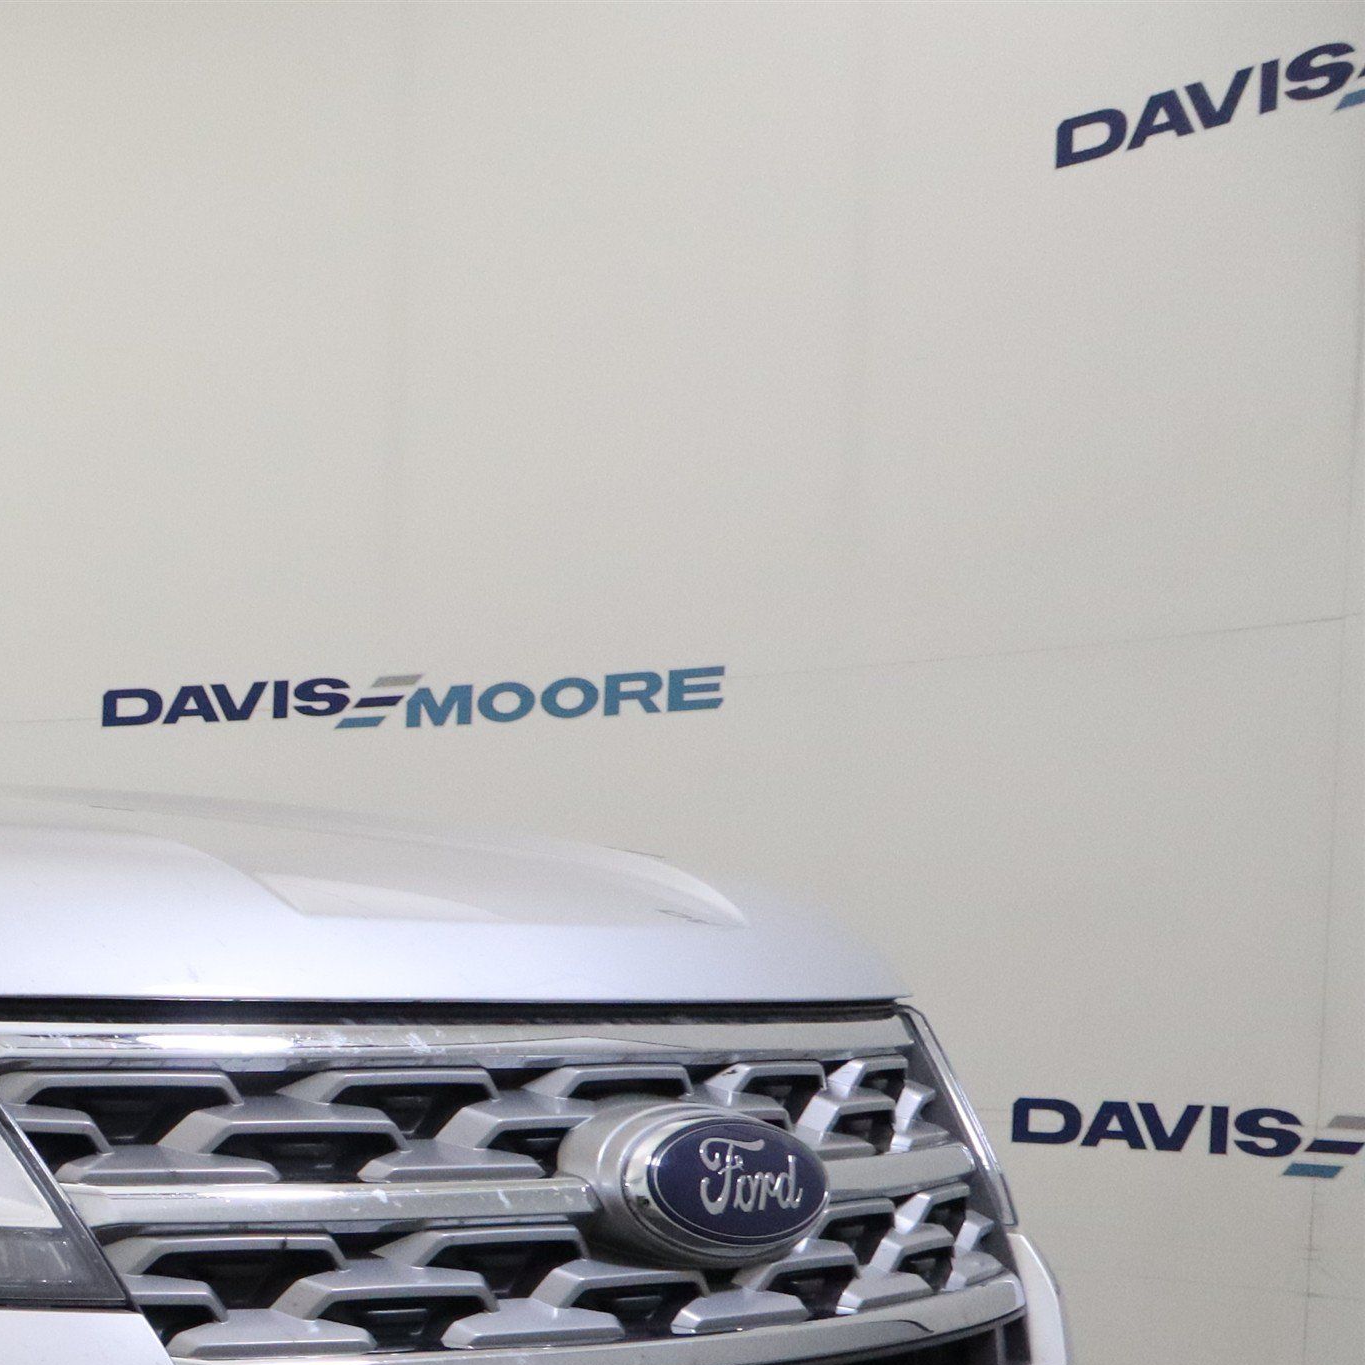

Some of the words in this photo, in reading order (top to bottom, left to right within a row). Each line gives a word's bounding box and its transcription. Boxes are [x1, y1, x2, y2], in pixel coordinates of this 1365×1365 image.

[1055, 42, 1356, 169] DAVIS
[101, 676, 351, 728] DAVIS
[405, 665, 726, 728] MOORE
[1011, 1097, 1304, 1158] DAVIS
[698, 1137, 804, 1216] Ford
